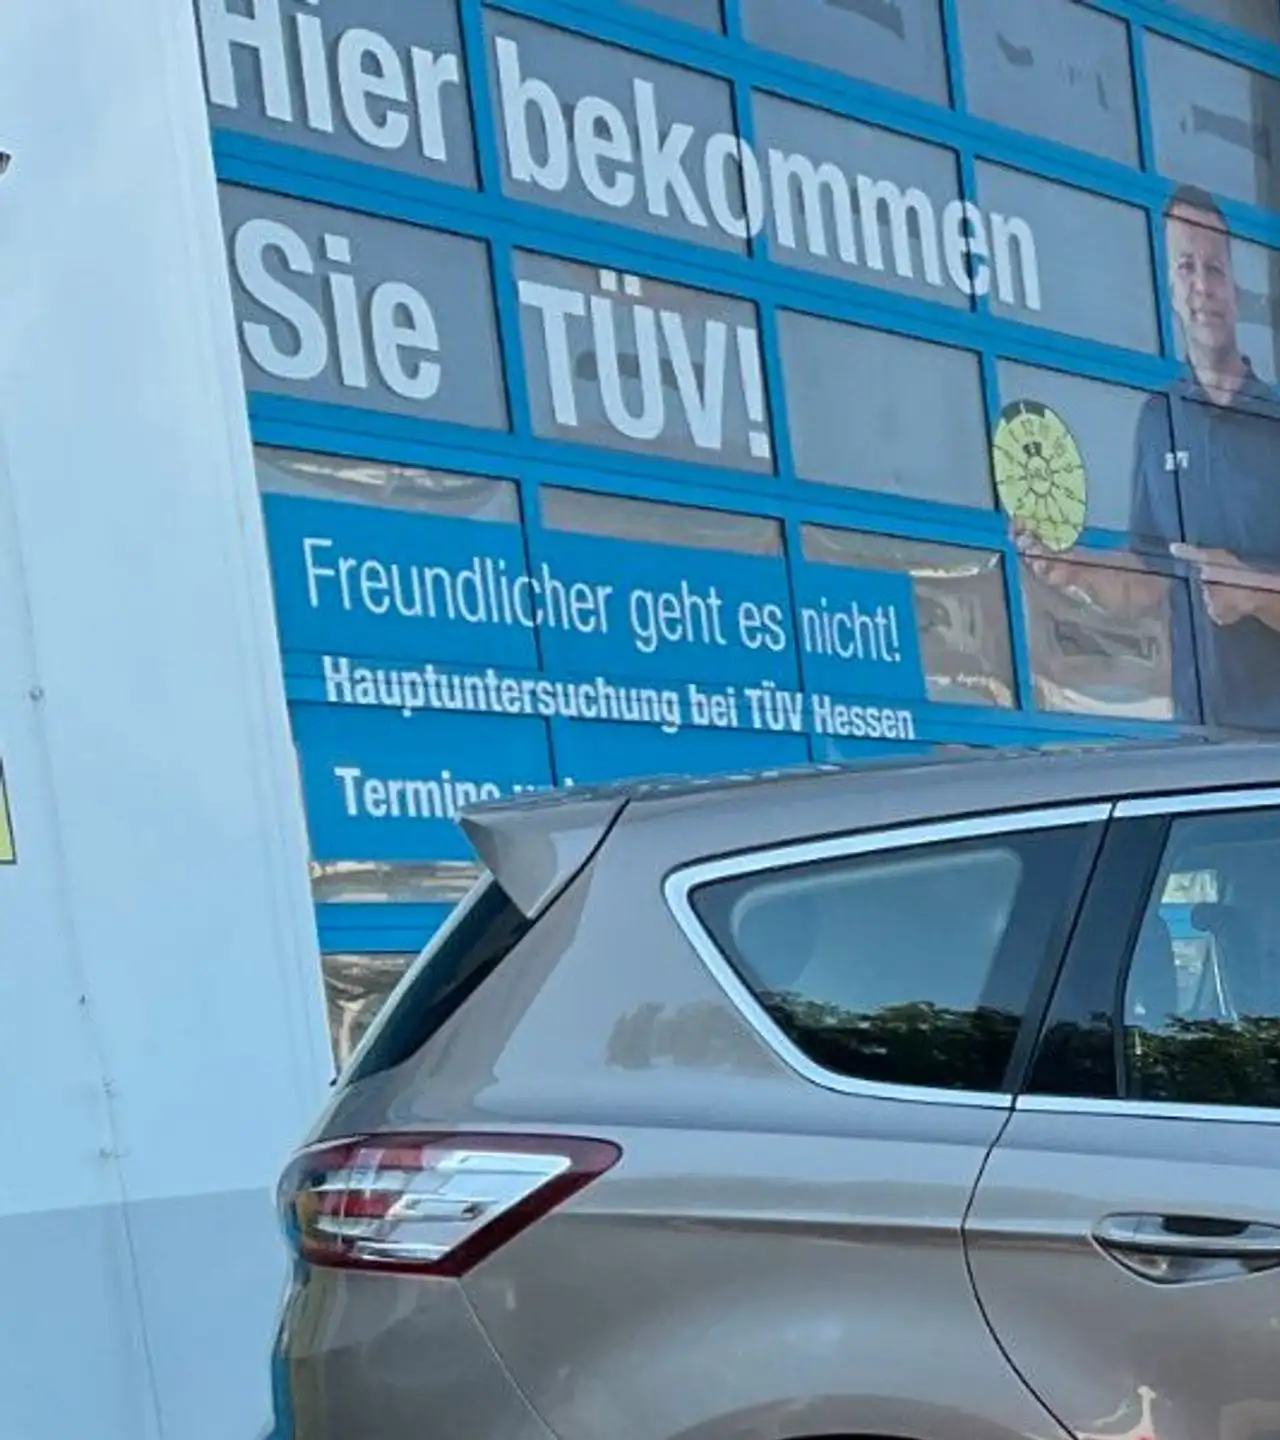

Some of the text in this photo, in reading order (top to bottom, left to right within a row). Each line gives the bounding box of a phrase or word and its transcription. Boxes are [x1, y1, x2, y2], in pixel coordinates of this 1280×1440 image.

[199, 0, 1041, 311] Hier bekommen
[232, 217, 771, 459] Sie TÜV!
[302, 537, 902, 662] Freundlicher geht es nicht!
[322, 654, 915, 741] Hauptuntersuchung bei TÜV Hessen
